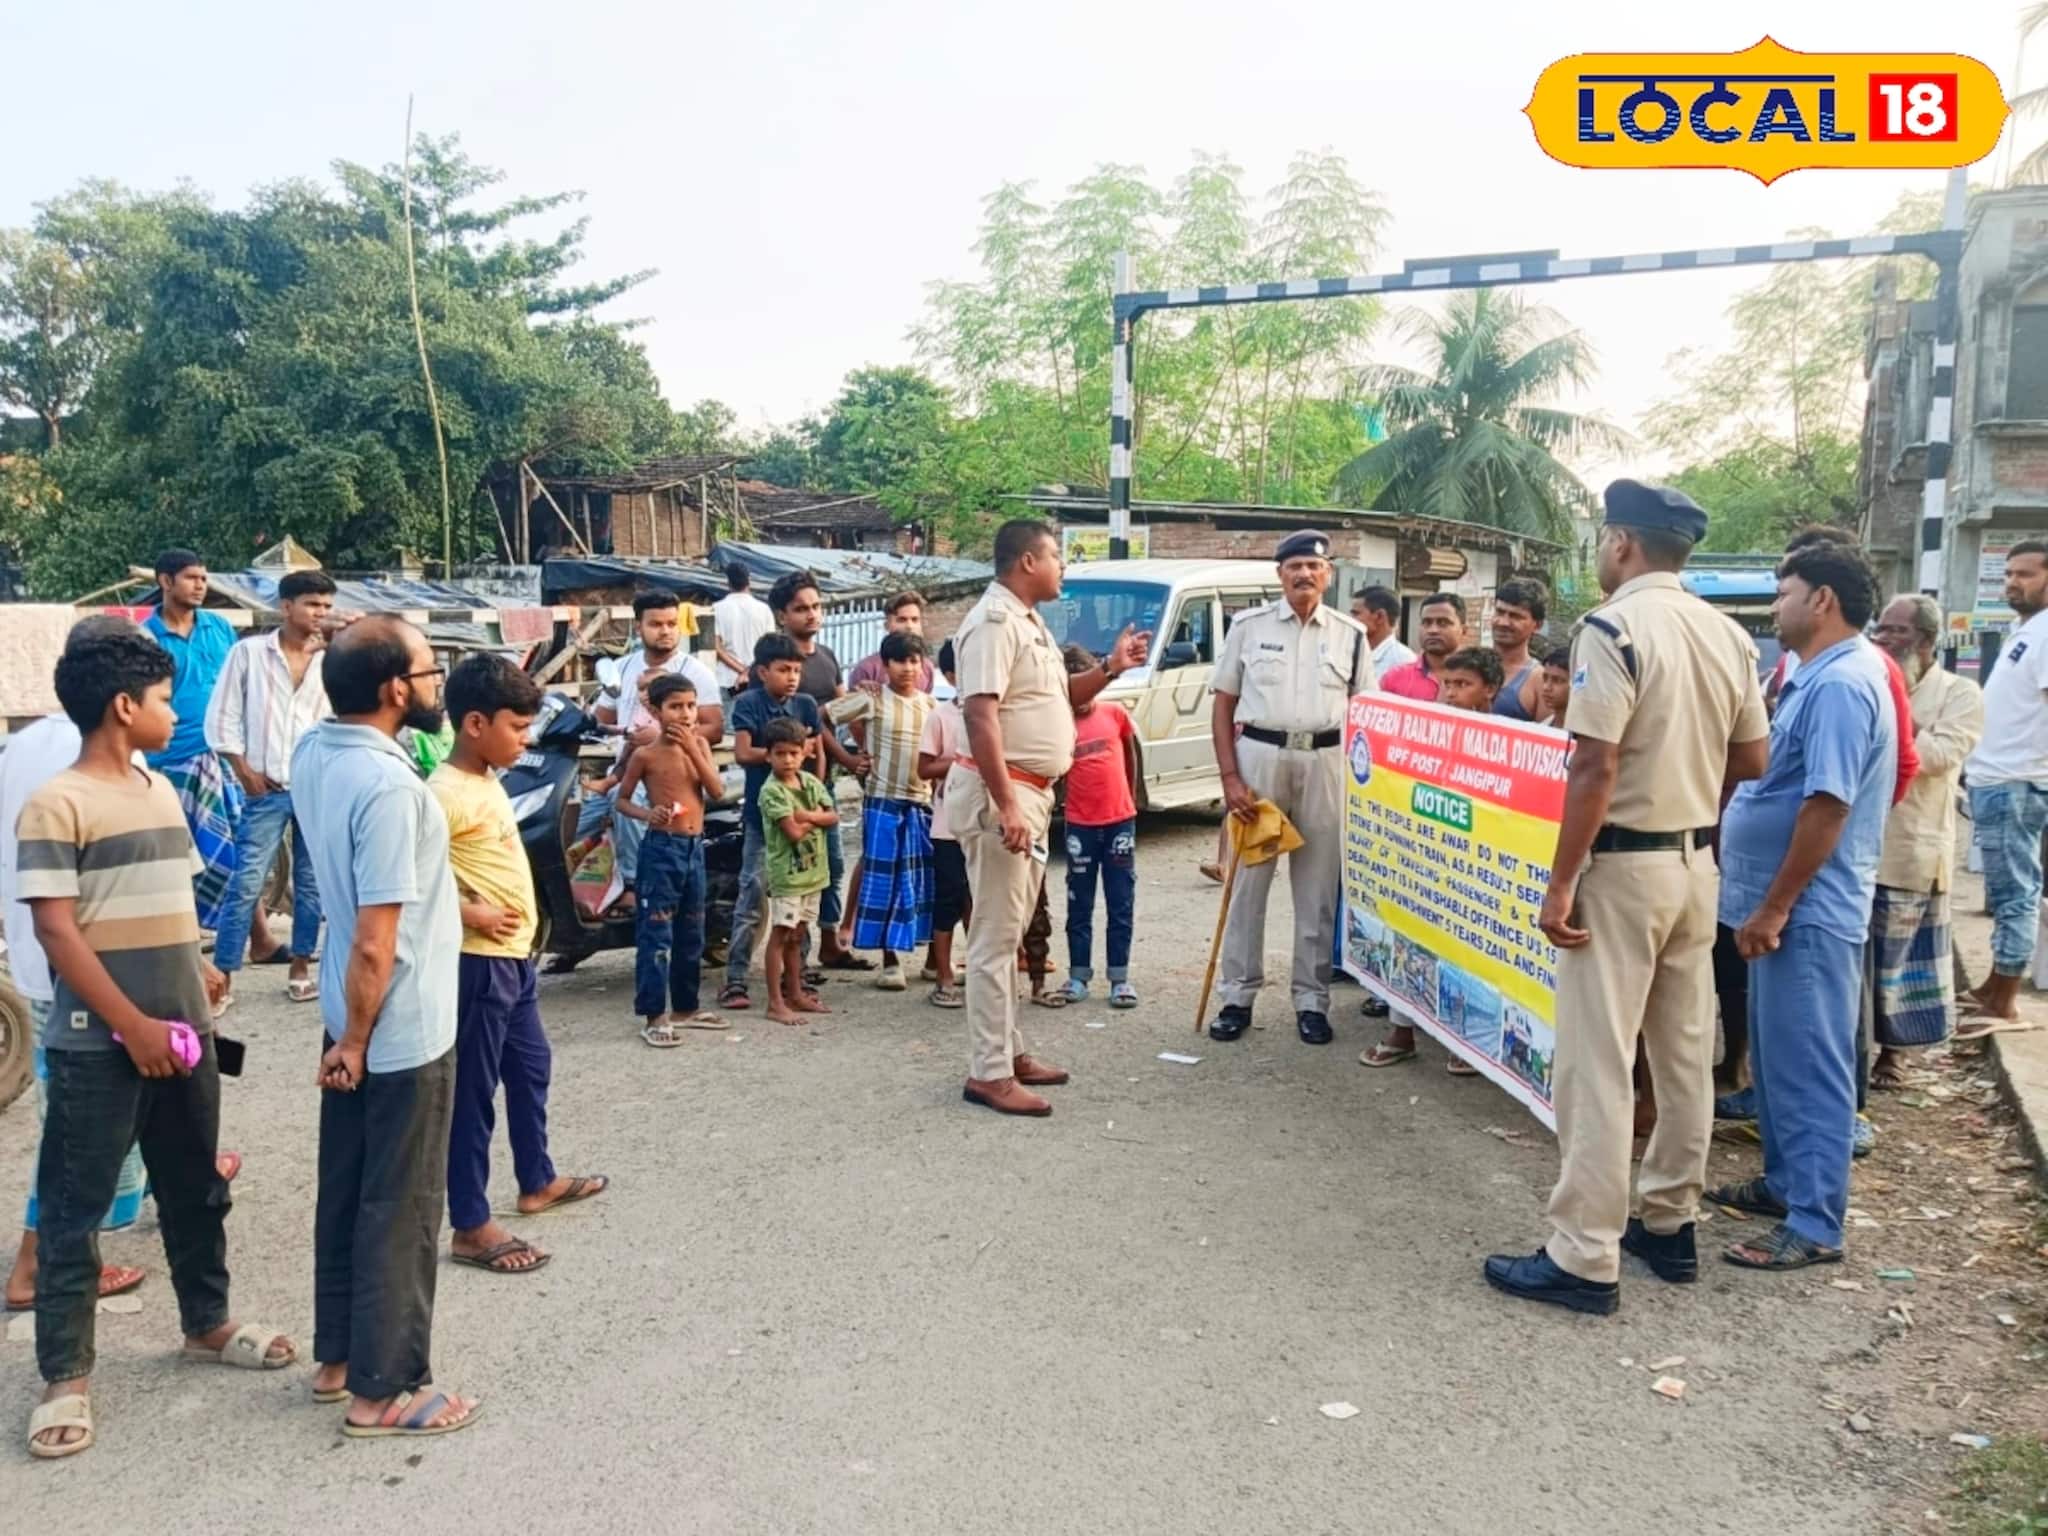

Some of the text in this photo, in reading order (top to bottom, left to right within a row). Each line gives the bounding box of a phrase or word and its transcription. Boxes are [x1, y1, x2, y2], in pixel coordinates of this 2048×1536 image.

[1350, 701, 1400, 738] EASTERN
[1401, 713, 1456, 750] RAILWAY
[1463, 726, 1508, 767] MALDA
[1387, 745, 1410, 766] RPF
[1410, 751, 1442, 776] POST
[1450, 762, 1512, 799] JANGIPUR
[1414, 785, 1469, 825] NOTICE
[1385, 807, 1412, 831] PEOPLE
[1416, 822, 1435, 840] ARE
[1477, 844, 1492, 862] DO
[1498, 851, 1518, 873] NOT
[1451, 856, 1465, 873] AS
[1466, 863, 1474, 877] A
[1477, 866, 1512, 895] RESULT
[1370, 861, 1388, 878] AND
[1414, 880, 1469, 920] PUNISHABLE
[1470, 909, 1524, 946] OFFIENCE
[1510, 906, 1519, 920] &
[1453, 924, 1484, 951] YEARS
[1513, 953, 1535, 977] AND
